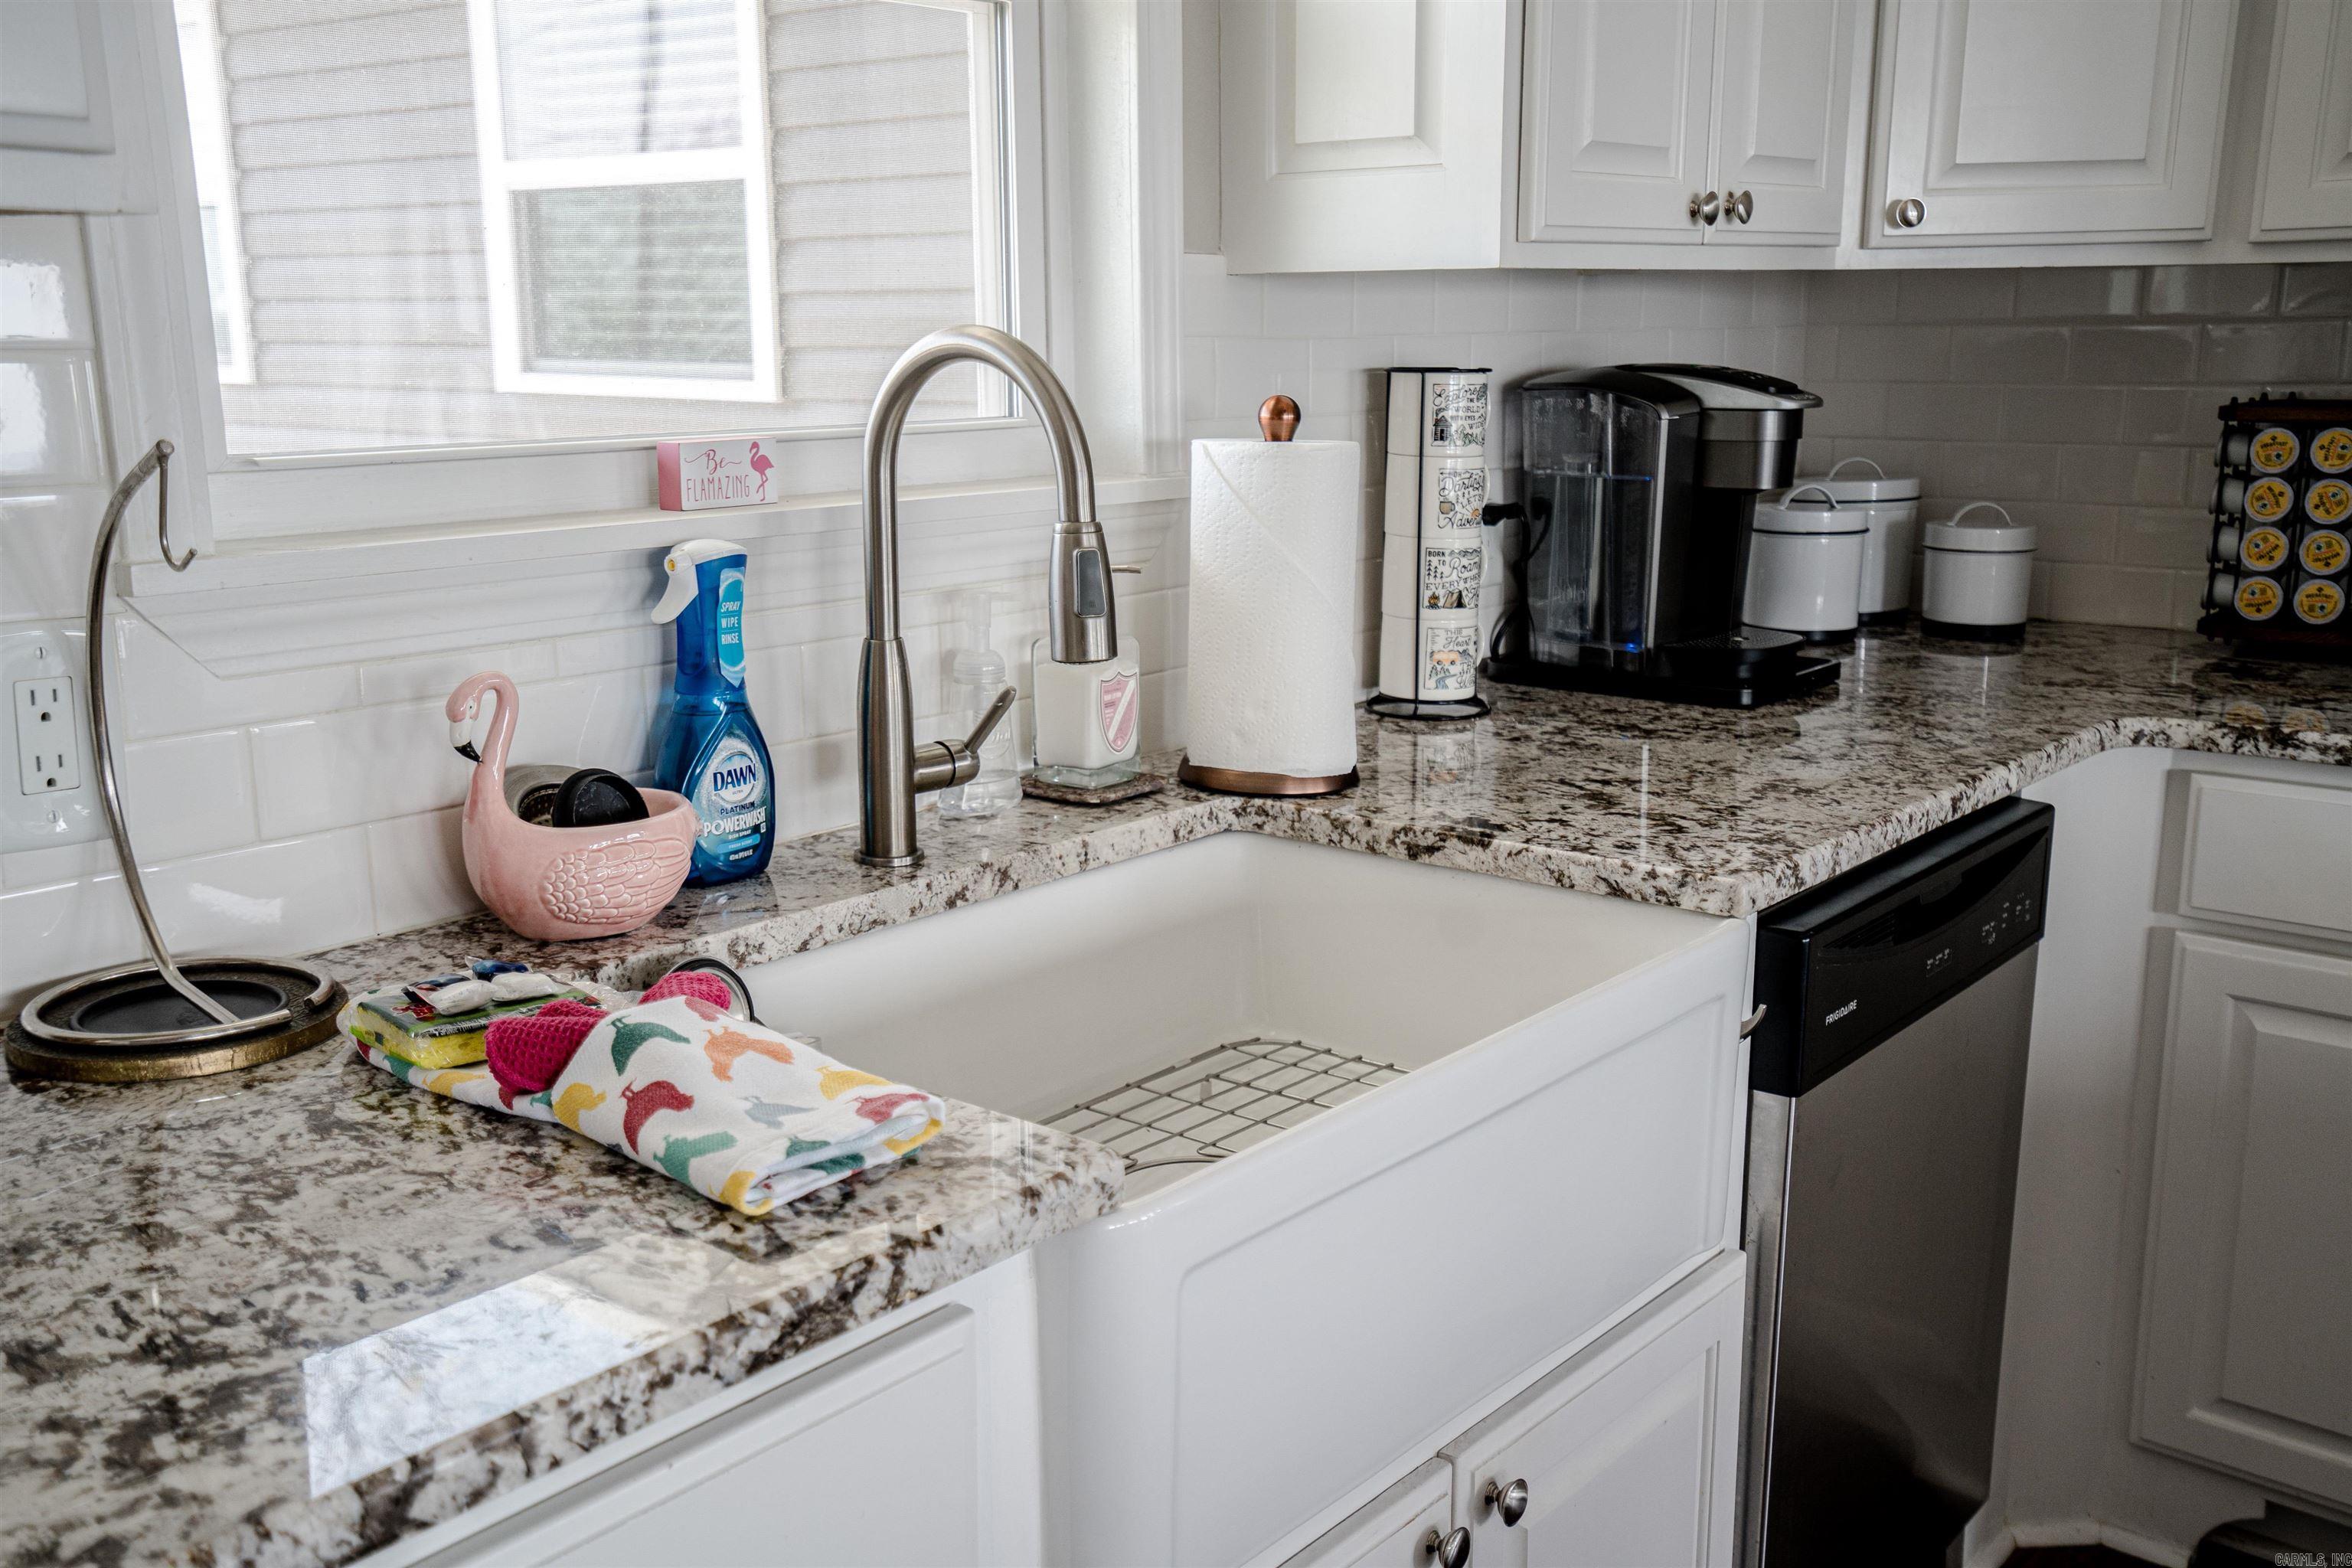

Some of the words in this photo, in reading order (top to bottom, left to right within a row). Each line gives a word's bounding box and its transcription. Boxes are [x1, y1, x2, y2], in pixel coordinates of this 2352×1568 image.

[687, 475, 750, 501] FLAMAZING
[721, 600, 741, 612] SPRAY
[720, 616, 739, 629] WIPE
[721, 632, 740, 645] RINSE
[713, 763, 756, 792] DAWN
[720, 801, 756, 815] PLATINUM
[703, 806, 767, 837] POWERWASH
[1825, 999, 1857, 1026] FRIGIDAIRE
